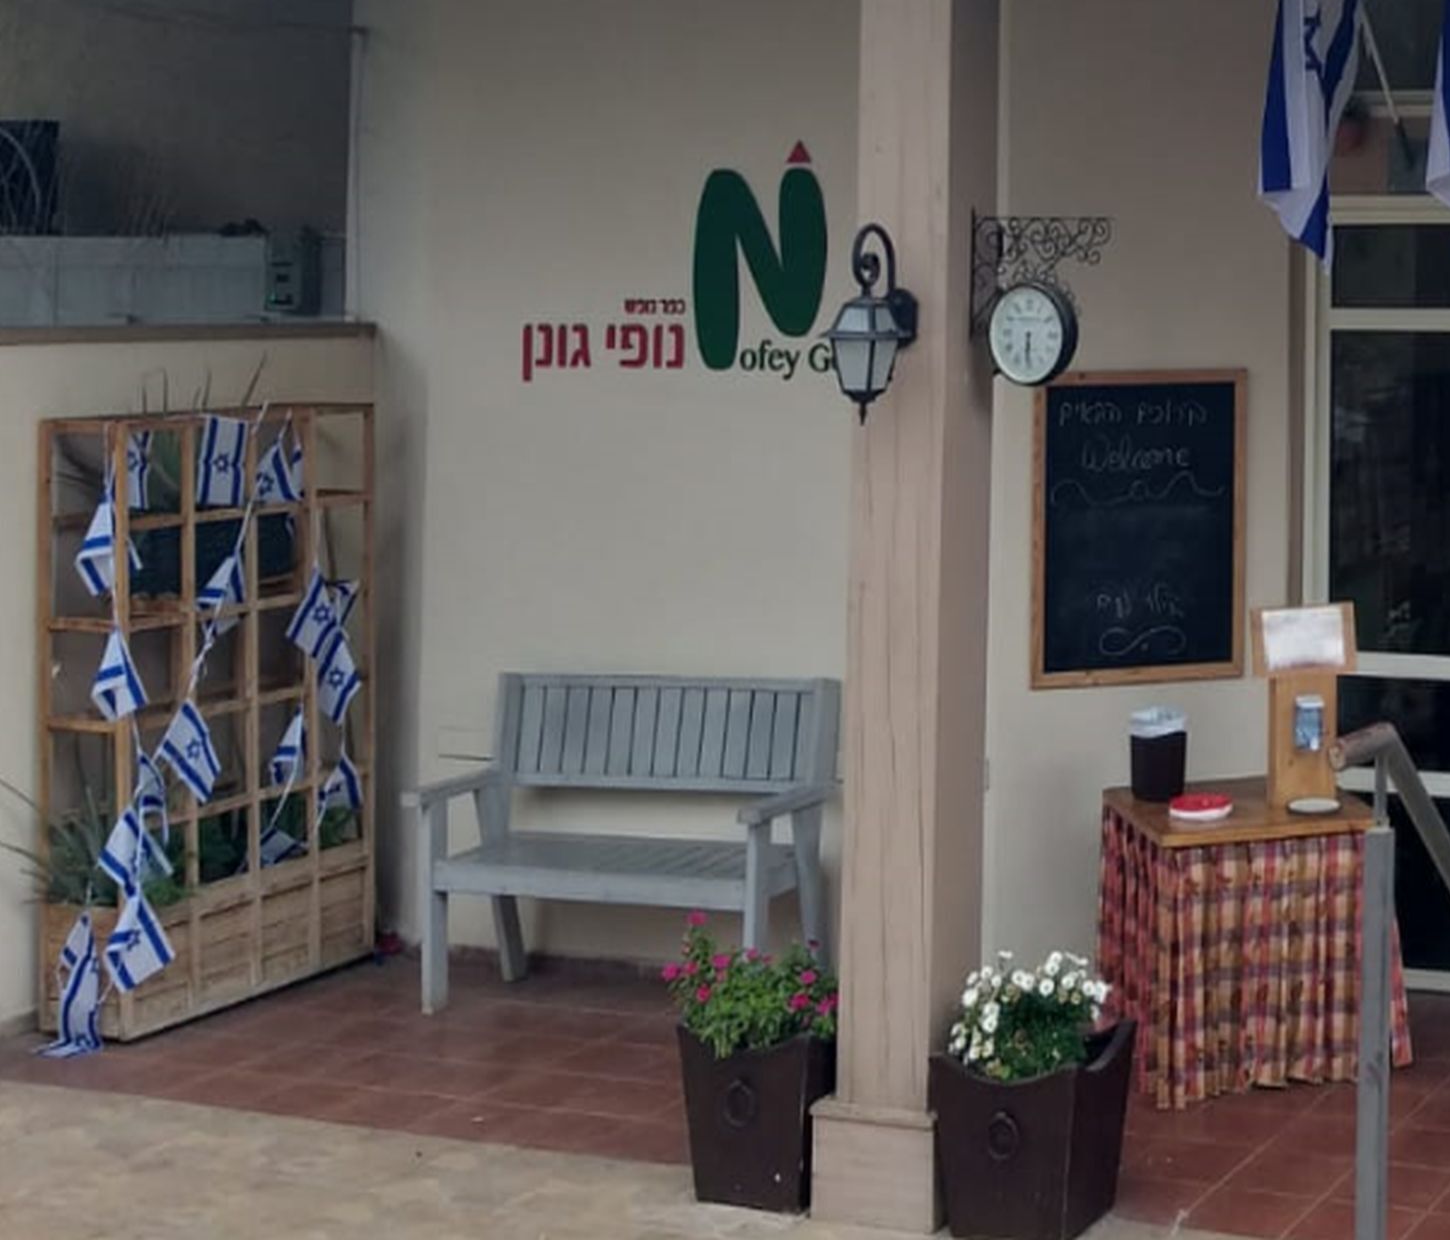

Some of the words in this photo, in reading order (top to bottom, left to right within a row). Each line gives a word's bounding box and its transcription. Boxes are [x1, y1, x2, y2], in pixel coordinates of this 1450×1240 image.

[624, 298, 657, 315] נופש
[659, 298, 686, 315] כפר
[522, 322, 592, 383] גונן
[605, 322, 685, 369] נופי
[1080, 432, 1191, 473] Welcome
